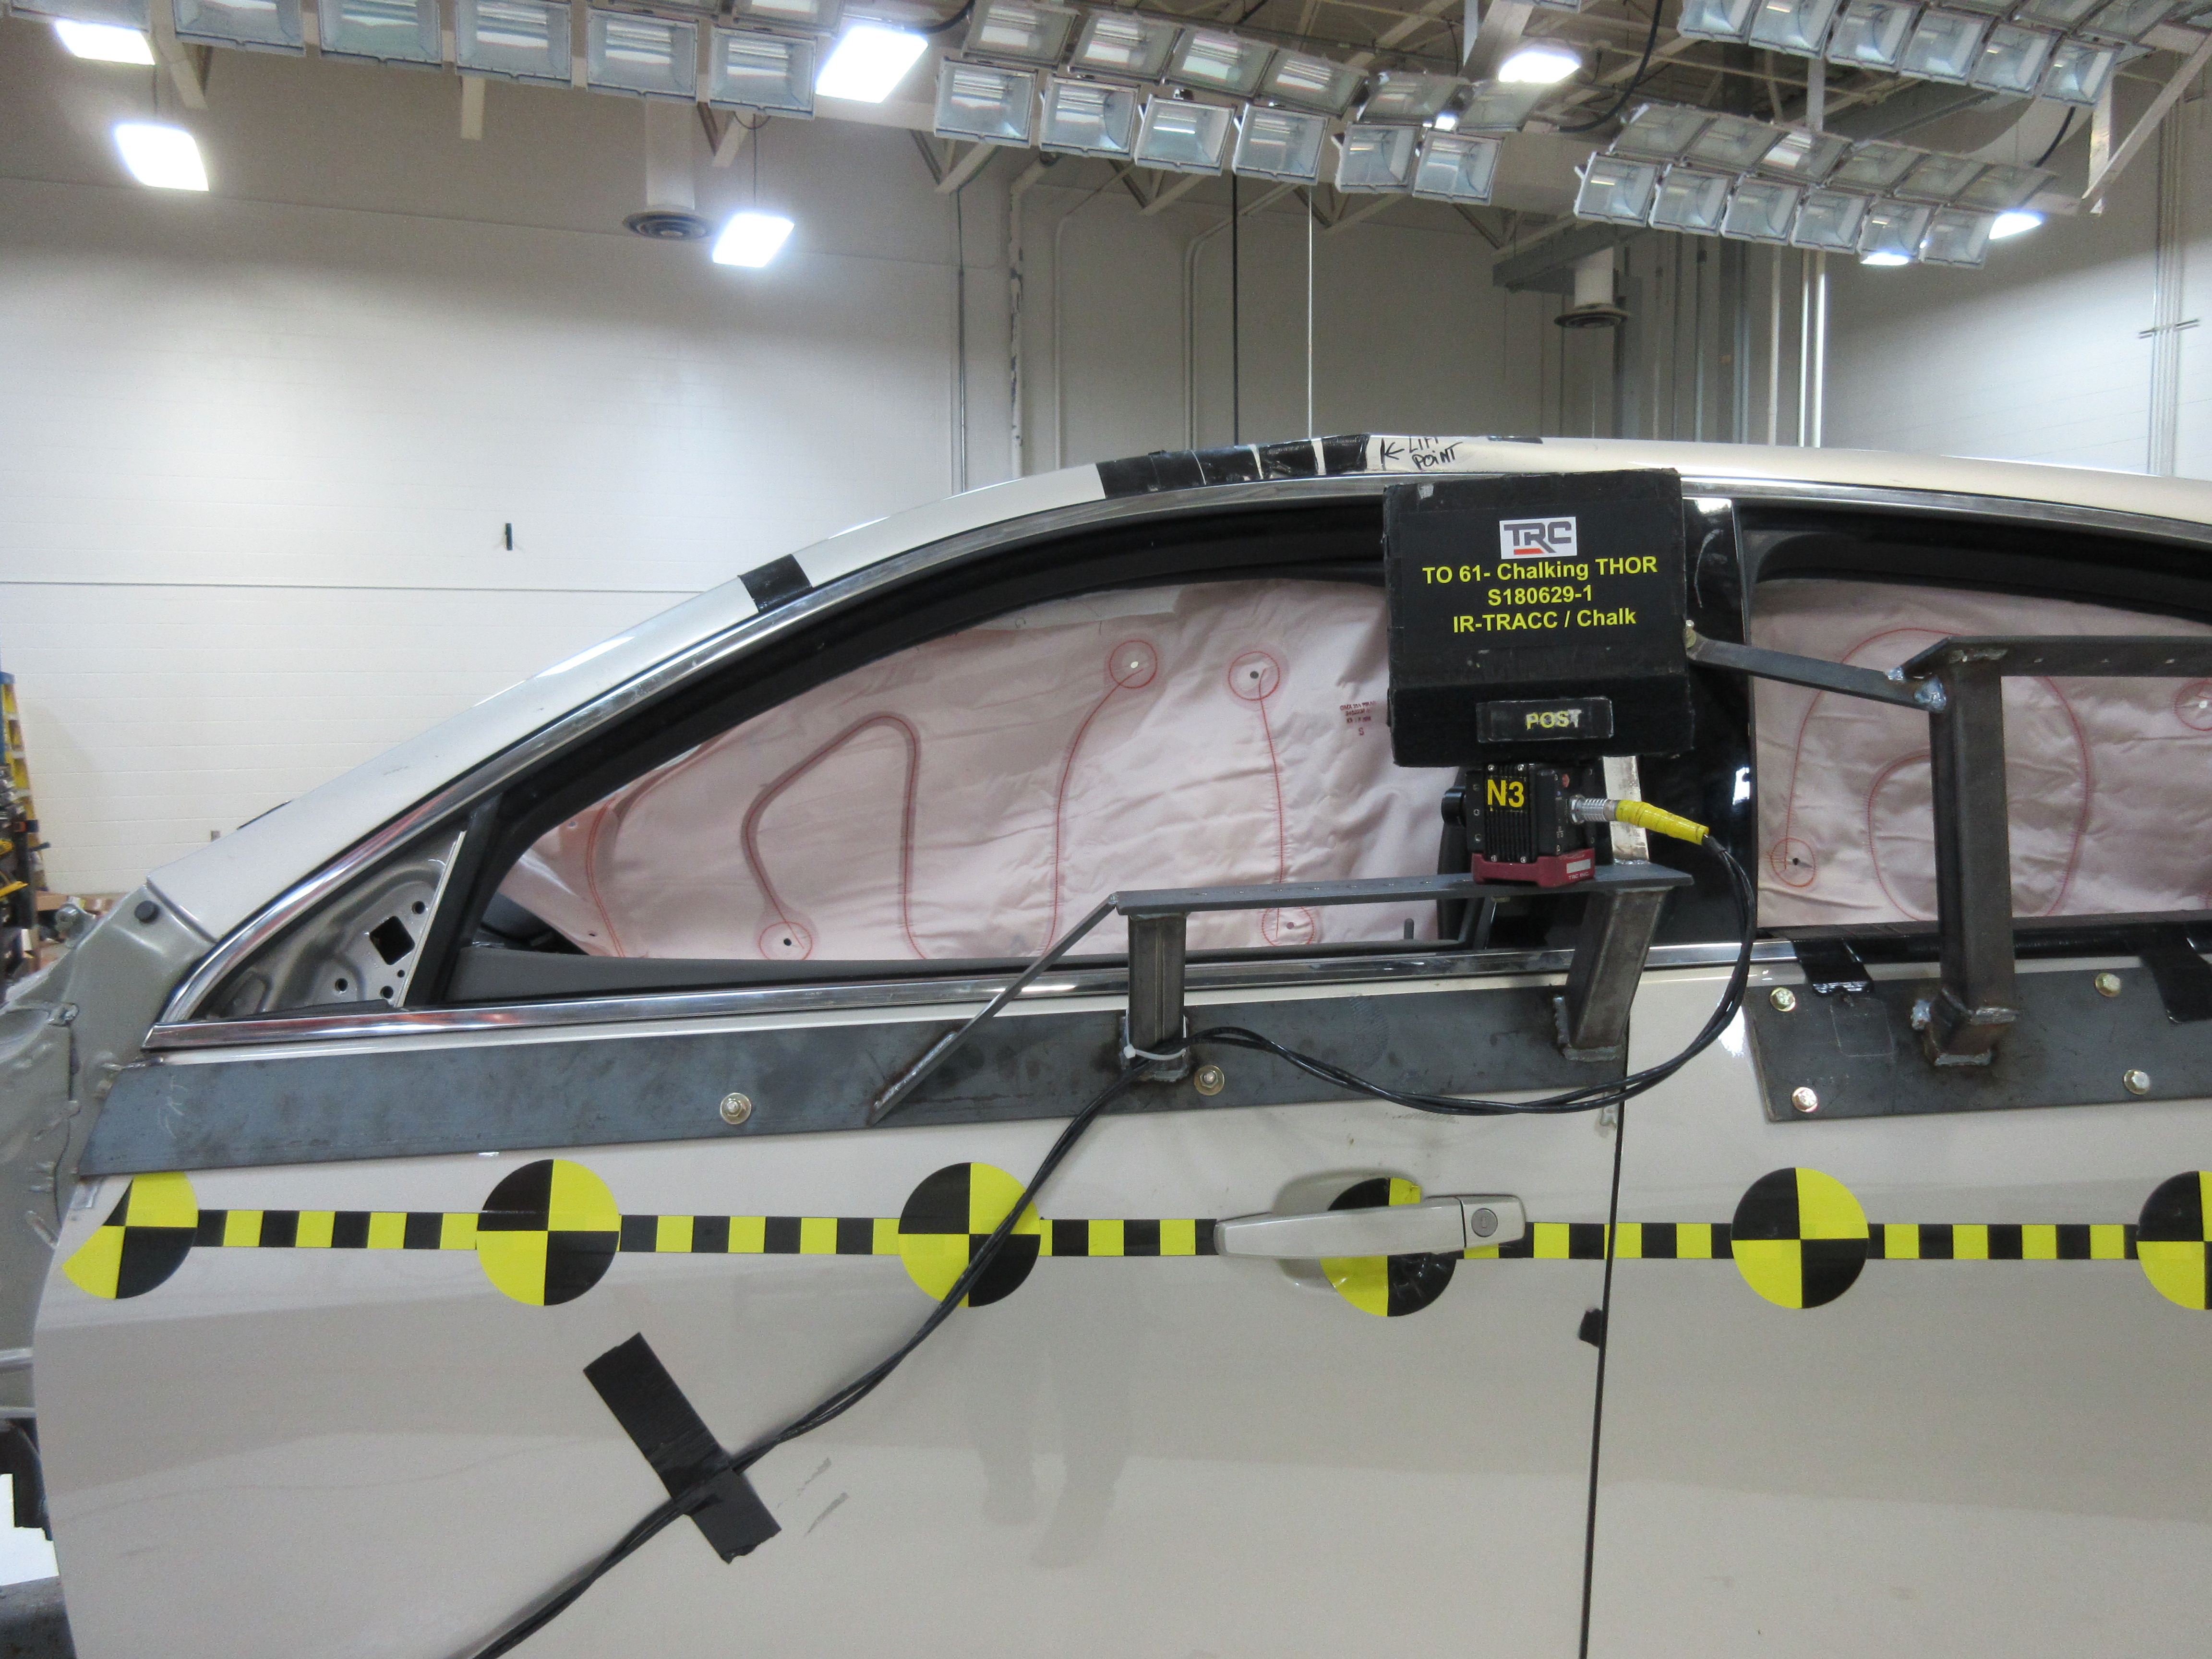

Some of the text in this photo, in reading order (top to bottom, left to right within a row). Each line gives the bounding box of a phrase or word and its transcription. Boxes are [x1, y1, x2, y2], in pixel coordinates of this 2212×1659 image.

[1503, 521, 1572, 554] TRC
[1422, 556, 1658, 584] TO 61- Chalking THOR
[1487, 584, 1593, 607] S180629-1
[1453, 608, 1637, 634] IR-TRACC / Chalk
[1526, 709, 1583, 730] POST
[1487, 779, 1525, 808] N3
